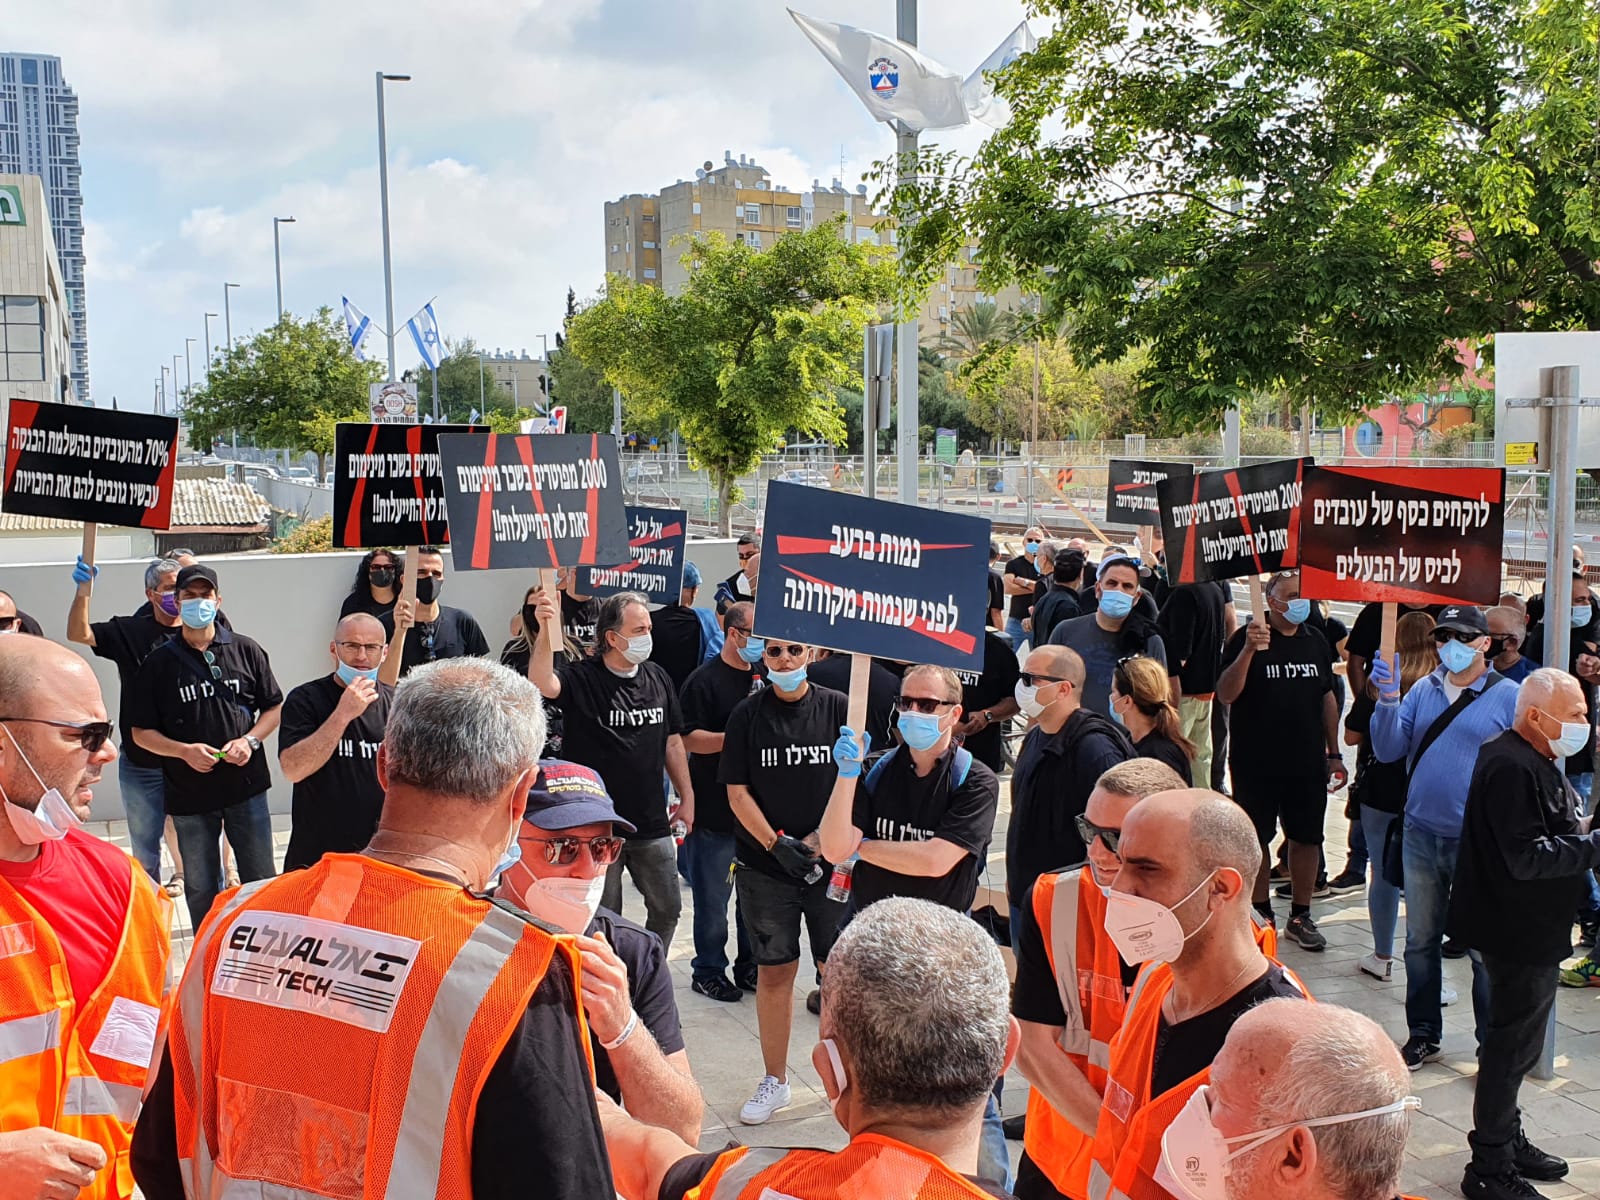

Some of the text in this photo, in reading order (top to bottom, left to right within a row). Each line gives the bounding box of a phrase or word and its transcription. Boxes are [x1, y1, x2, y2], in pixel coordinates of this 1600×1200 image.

[12, 424, 169, 468] 70% מהעובדים בהשלמת הכנסה
[348, 453, 442, 479] וטרים בשכר מינימום
[456, 458, 608, 493] 2000 מפוטרים בשכר מינימום
[1132, 470, 1150, 485] ברעב
[14, 469, 160, 509] עכשיו גונבים להם את הזכויות
[424, 489, 436, 521] לא
[1115, 494, 1143, 512] מקורונה
[1172, 502, 1210, 528] מינימום
[1210, 496, 1238, 522] בשכר
[1239, 489, 1280, 517] מפוטרים
[1313, 490, 1490, 536] לוקחים כסף של עובדים
[552, 503, 567, 539] לא
[568, 511, 590, 538] זאת
[635, 514, 648, 539] על
[650, 515, 663, 540] אל
[829, 524, 921, 568] נמות ברעב
[1255, 524, 1268, 554] לא
[1269, 528, 1289, 552] זאת
[658, 549, 674, 567] את
[1336, 546, 1461, 584] לכיס של הבעלים
[589, 567, 667, 593] והעשירים חוגגים
[783, 577, 959, 634] לפני שנמות מקורונה
[574, 624, 598, 637] צילו
[955, 671, 979, 687] הצי
[1266, 661, 1319, 679] הצילו !!!
[180, 679, 240, 702] הלו !!!
[609, 707, 664, 726] הצילו !!!
[339, 738, 382, 759] ילו !!!
[761, 743, 831, 767] הצילו !!!
[272, 968, 333, 997] TECH
